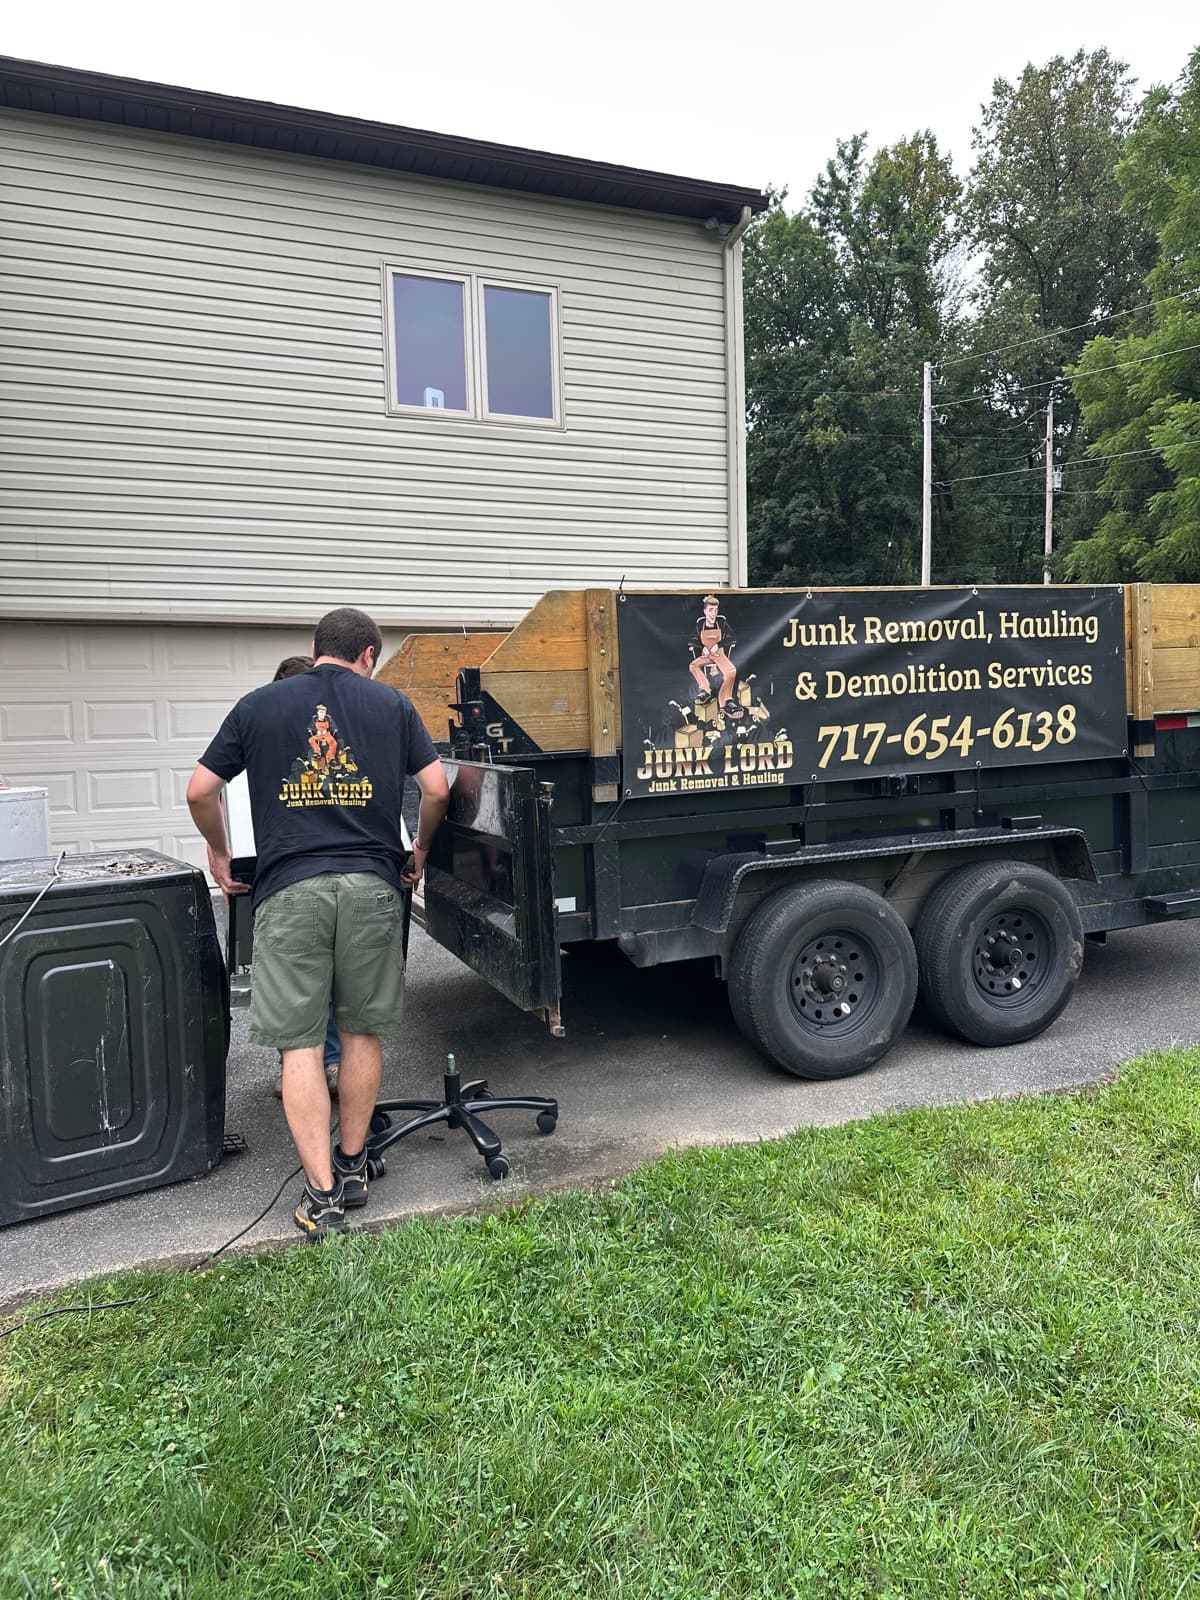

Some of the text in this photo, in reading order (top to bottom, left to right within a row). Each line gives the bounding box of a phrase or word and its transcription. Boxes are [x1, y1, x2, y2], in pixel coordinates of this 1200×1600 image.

[783, 609, 1099, 647] Junk Removal, Hauling
[794, 659, 1093, 700] & Demolition Services
[817, 704, 1077, 769] 717-654-6138
[636, 740, 793, 780] JUNK LORD
[279, 782, 373, 800] JUNK LORD
[648, 771, 785, 793] Junk Removal & Hauling
[286, 800, 304, 808] Junk
